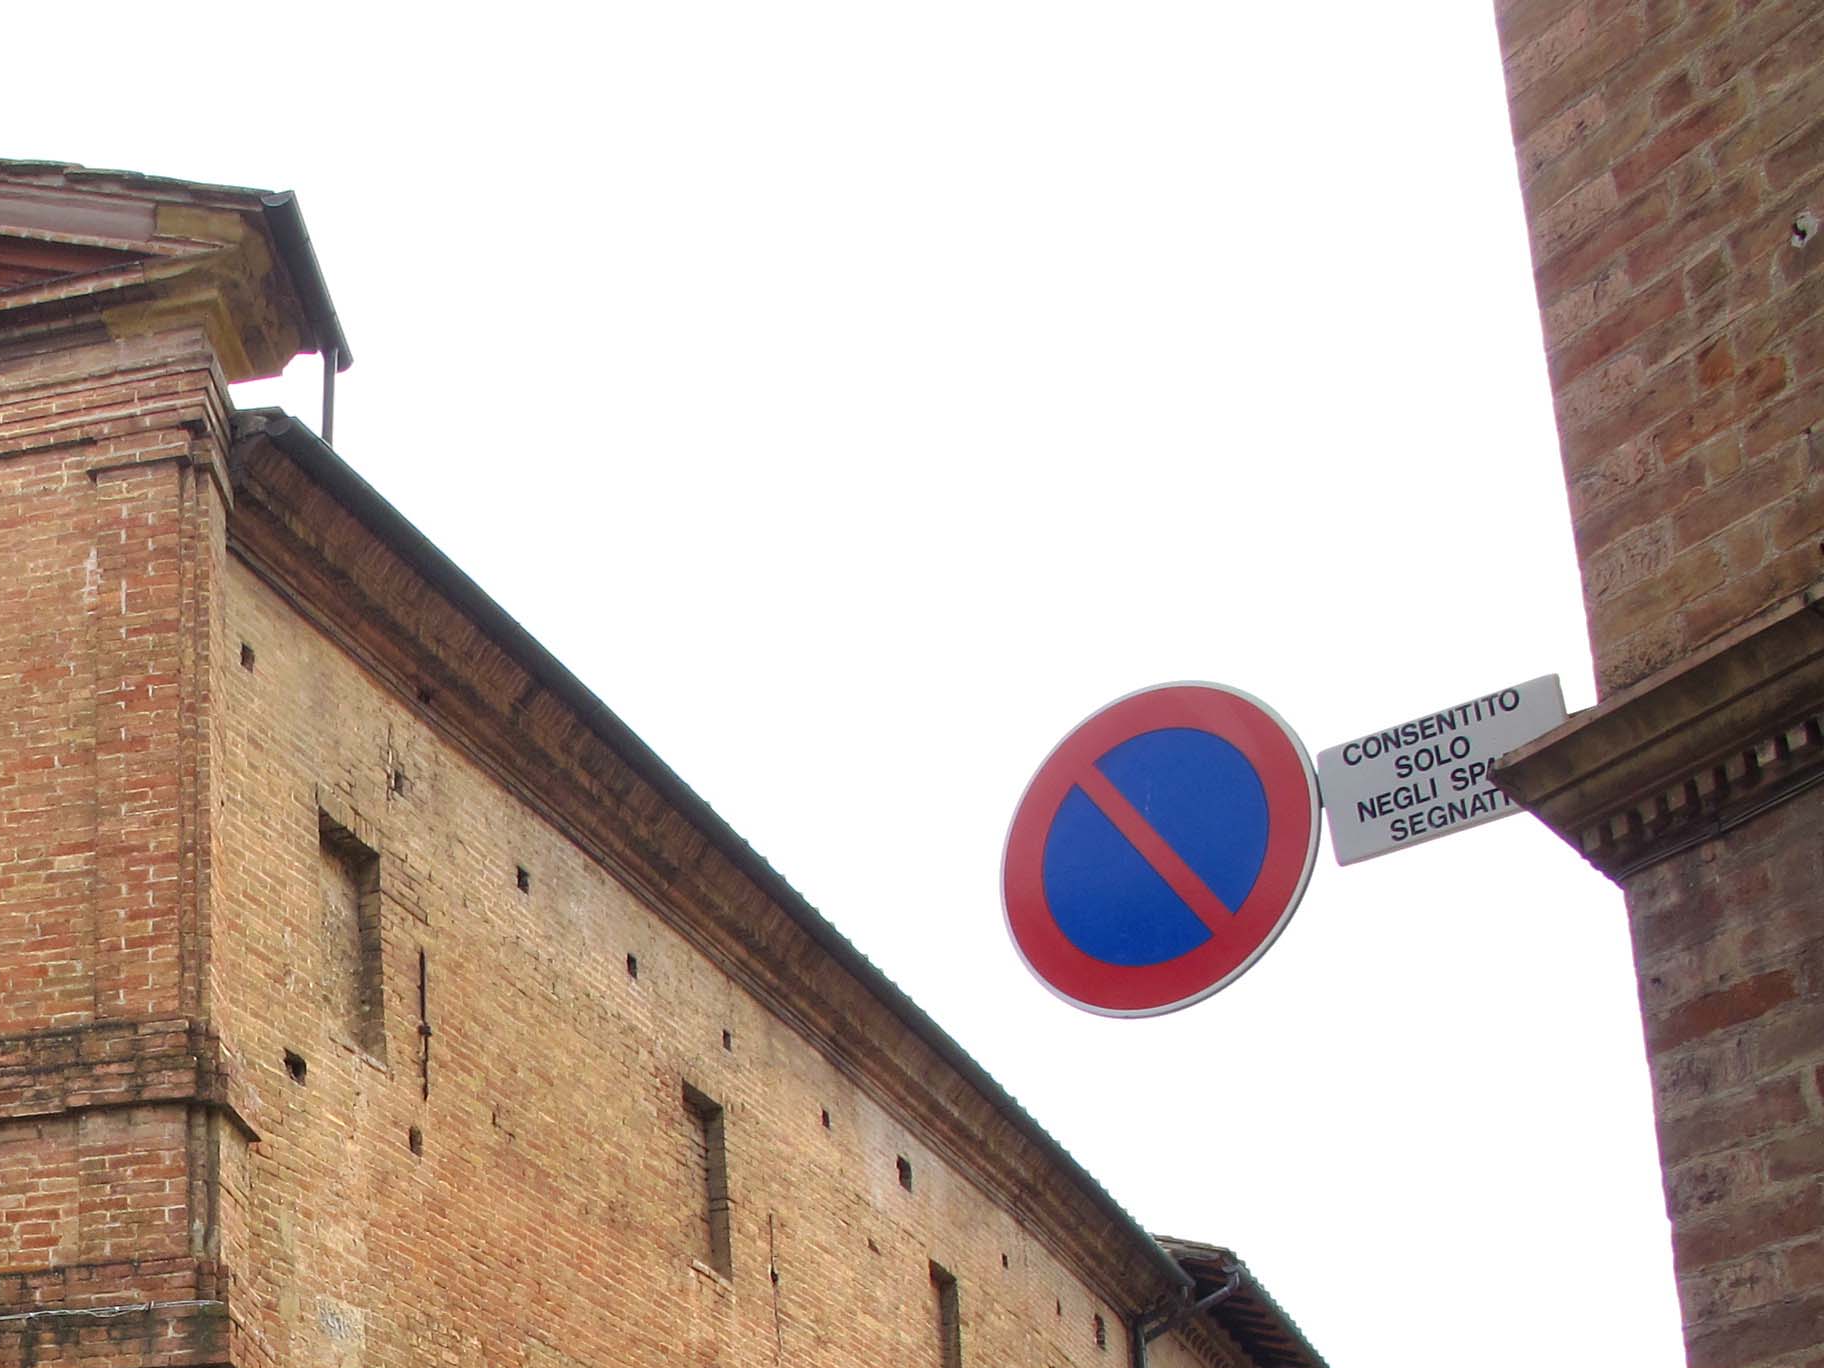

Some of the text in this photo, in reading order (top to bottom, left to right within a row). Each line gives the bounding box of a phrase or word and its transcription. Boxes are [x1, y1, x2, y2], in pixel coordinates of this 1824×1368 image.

[1342, 687, 1520, 767] CONSENTITO
[1394, 735, 1471, 778] SOLO
[1357, 778, 1438, 824] NEGLI
